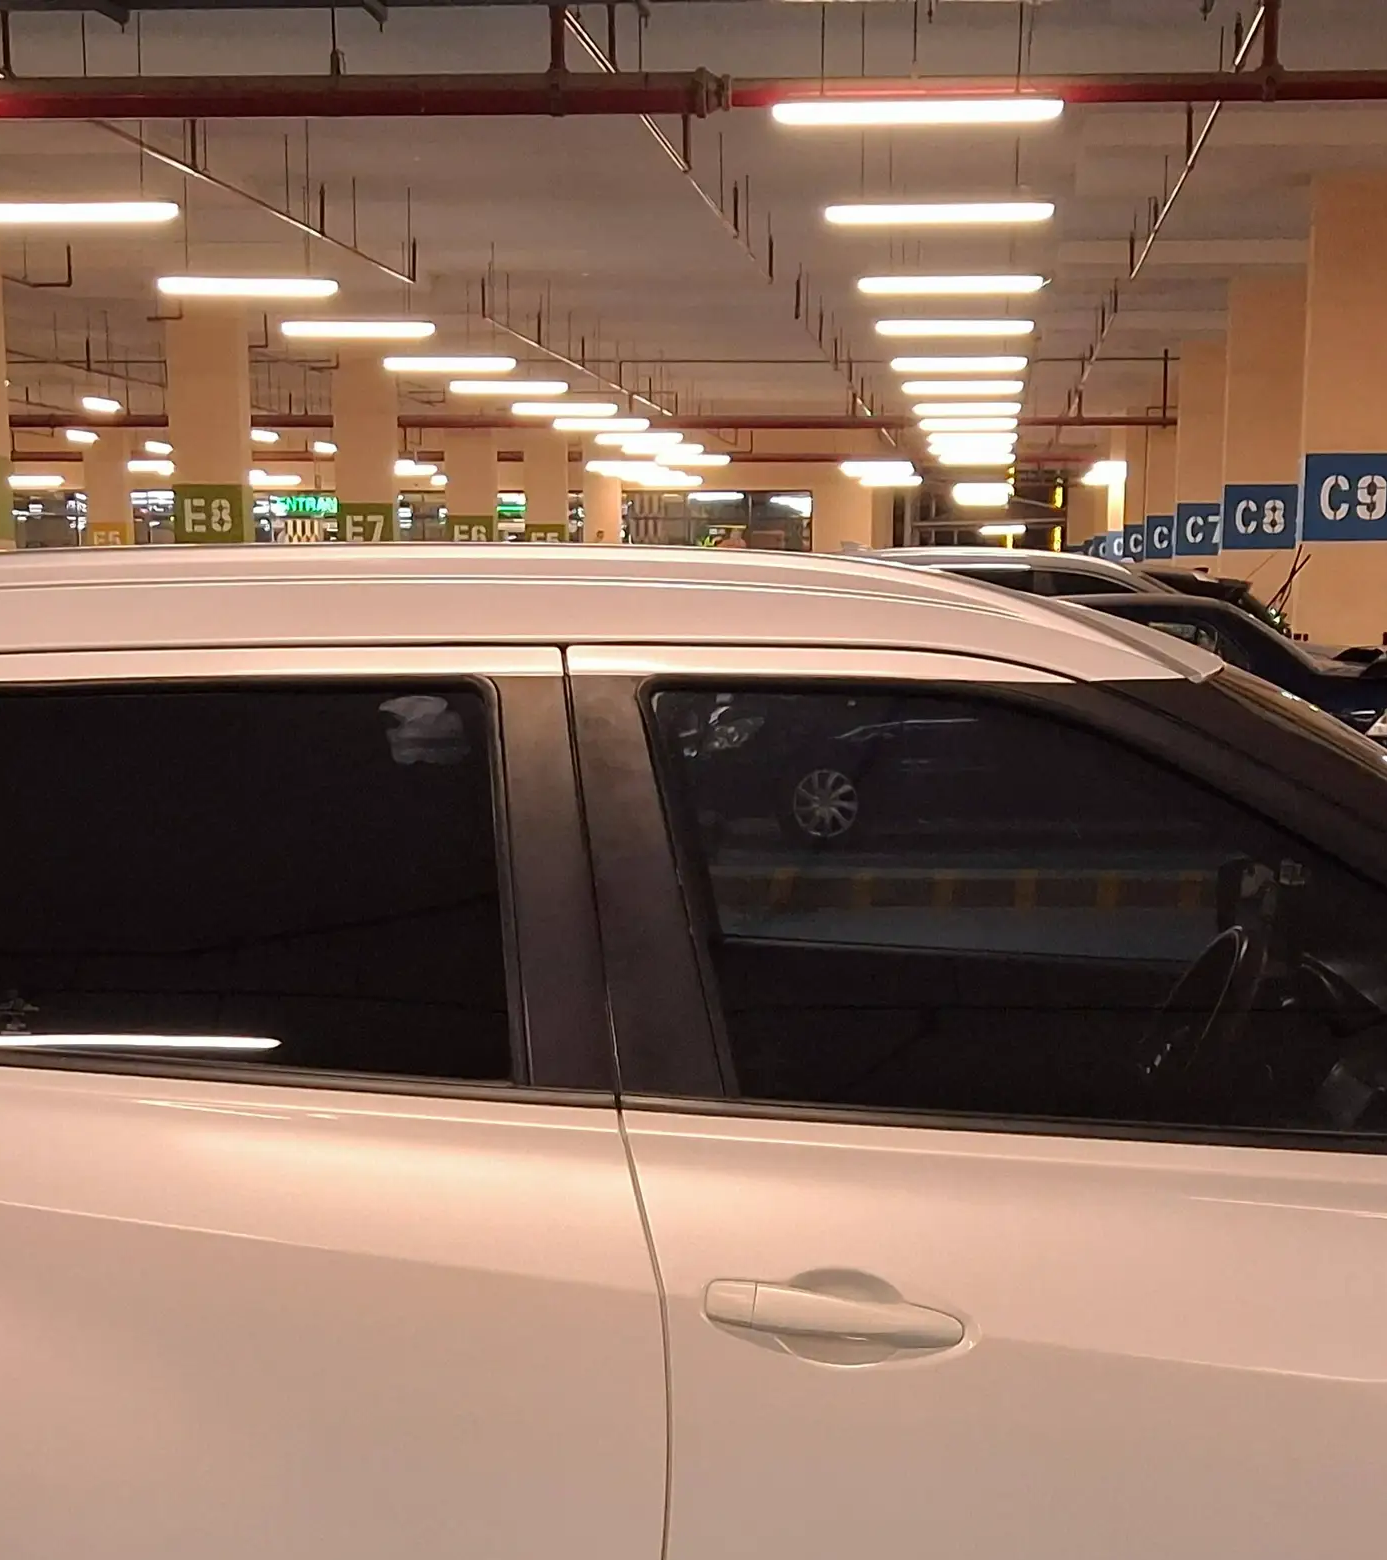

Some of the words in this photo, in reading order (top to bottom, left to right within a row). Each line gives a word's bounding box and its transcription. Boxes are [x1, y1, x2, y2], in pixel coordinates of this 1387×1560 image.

[1320, 474, 1387, 521] C9
[184, 498, 232, 533] E8
[346, 515, 384, 541] E7
[1185, 515, 1221, 544] C7
[1235, 499, 1285, 534] C8
[453, 524, 487, 542] E6
